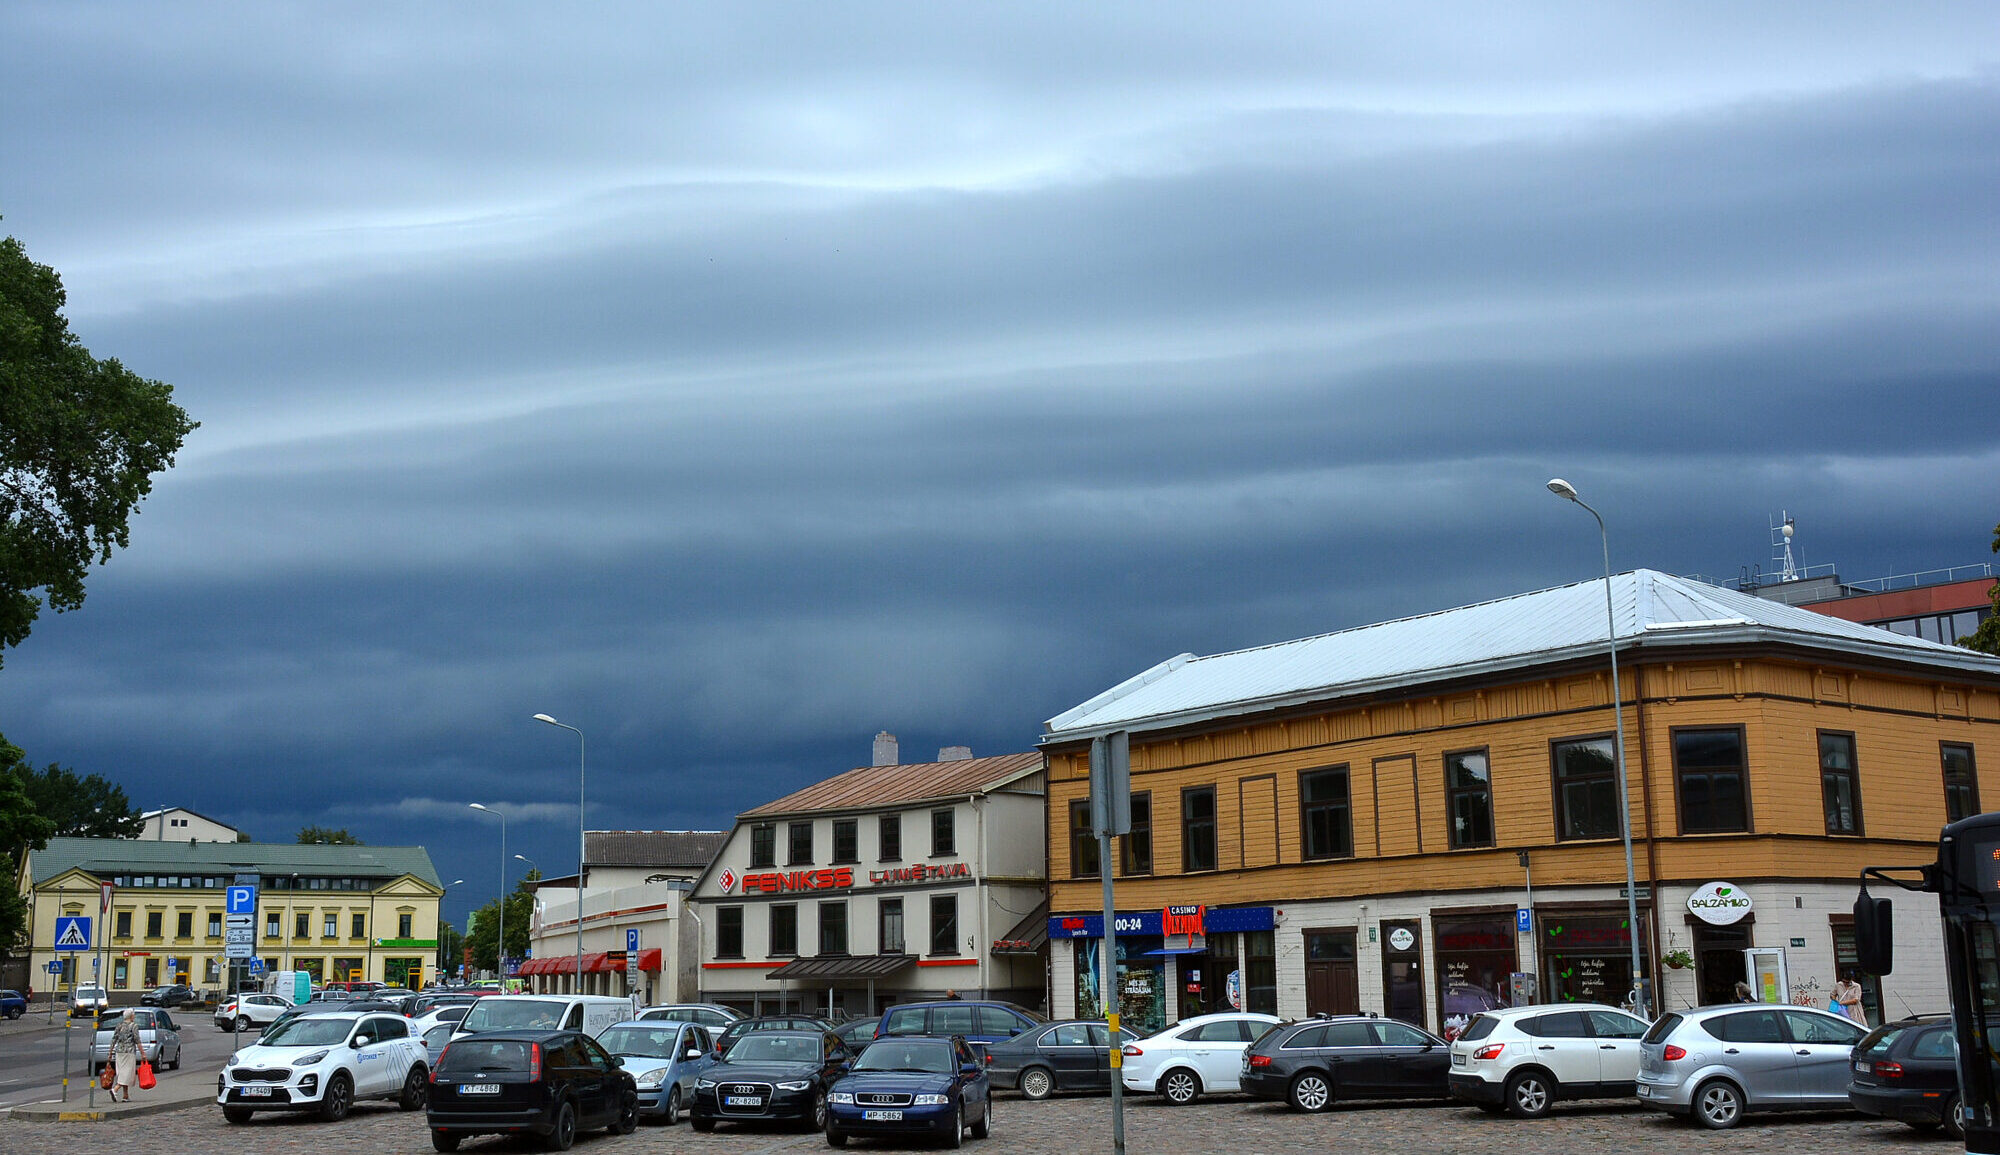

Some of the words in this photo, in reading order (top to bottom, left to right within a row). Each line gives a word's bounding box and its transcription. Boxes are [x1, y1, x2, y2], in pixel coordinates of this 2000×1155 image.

[742, 867, 854, 893] FENIKSS
[870, 863, 971, 882] LAIMĒTAVA
[233, 889, 250, 911] P
[1171, 906, 1196, 914] CASINO
[1519, 910, 1528, 924] P
[1115, 918, 1142, 931] 00-24
[1162, 904, 1207, 943] OLYMPIC
[628, 931, 636, 949] P
